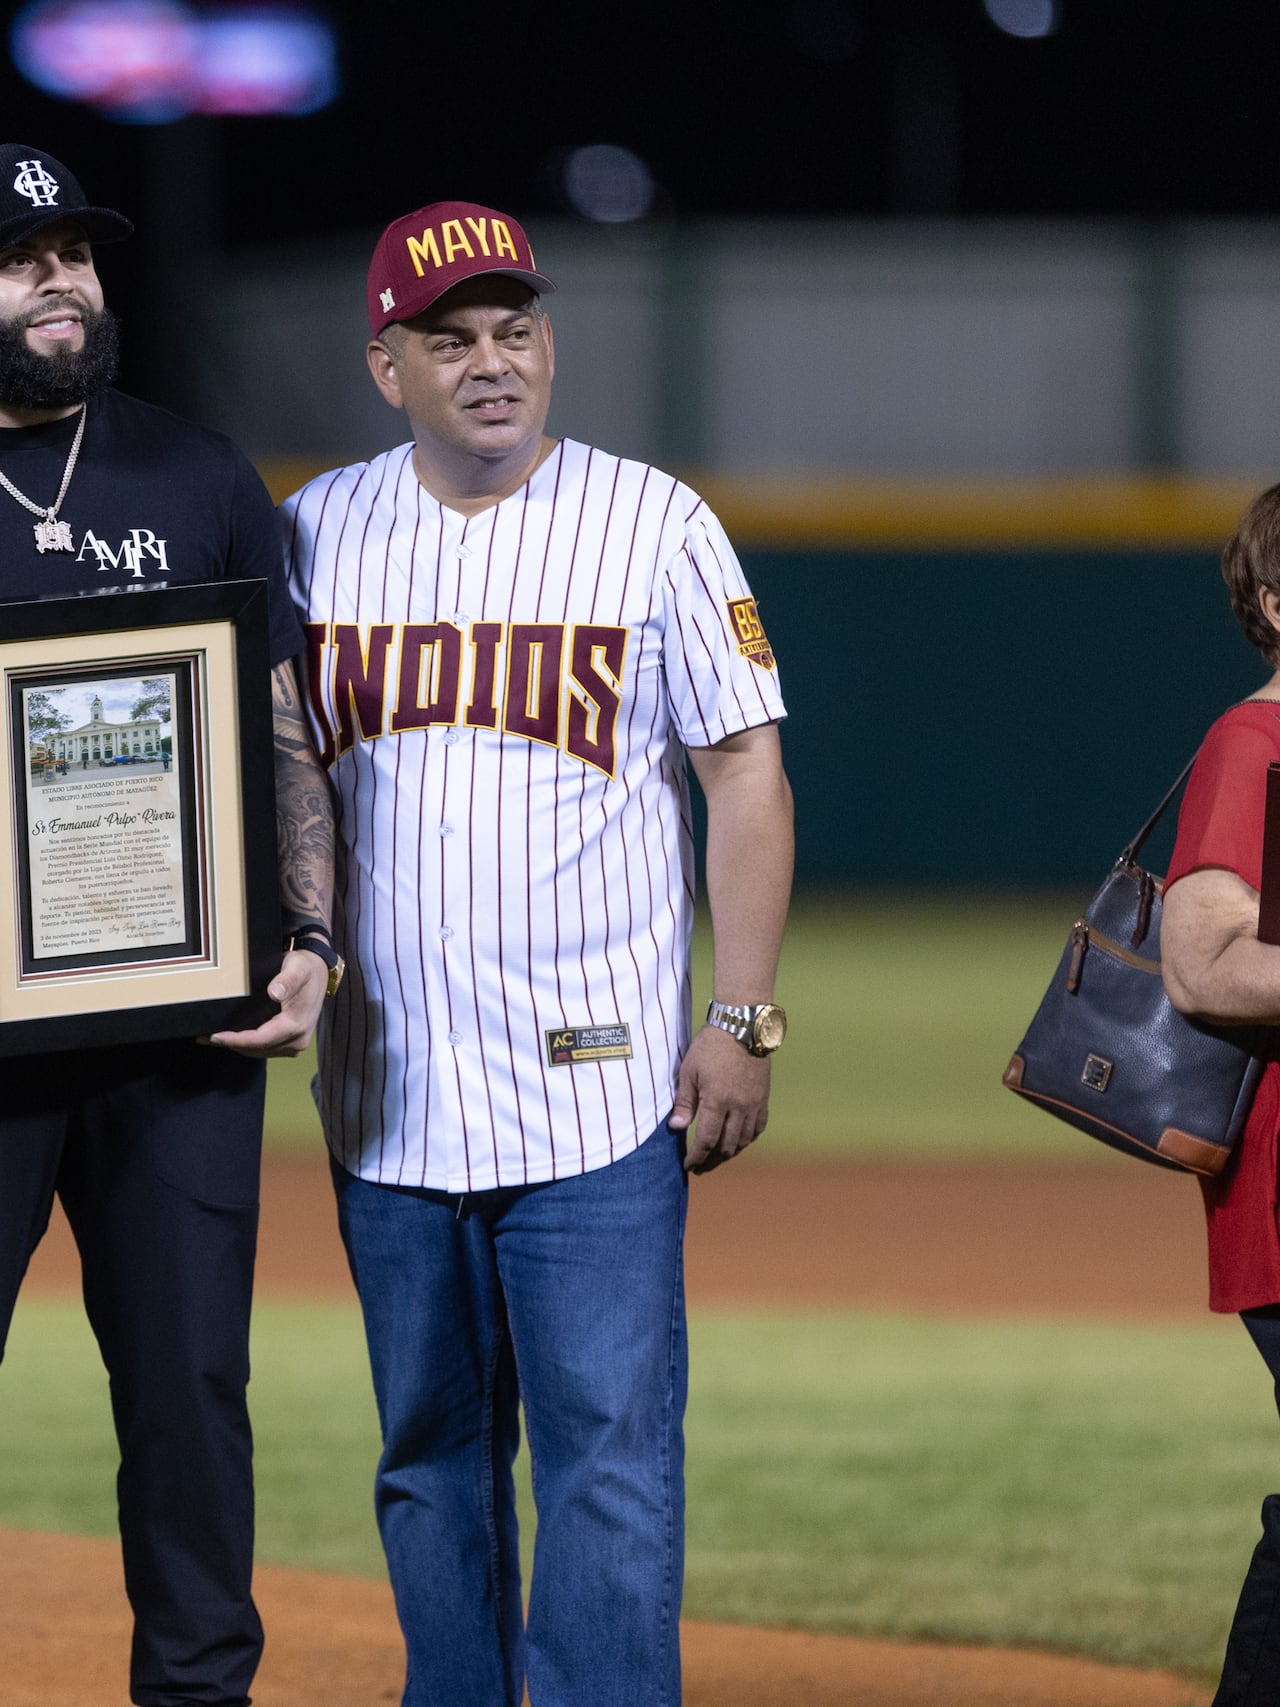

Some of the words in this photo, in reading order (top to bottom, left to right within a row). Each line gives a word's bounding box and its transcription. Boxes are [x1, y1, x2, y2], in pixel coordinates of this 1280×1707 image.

[406, 216, 518, 278] MAYA
[733, 602, 762, 641] 85
[553, 1032, 574, 1048] AC
[580, 1036, 627, 1047] COLLECTION
[582, 1028, 624, 1039] AUTHENTIC
